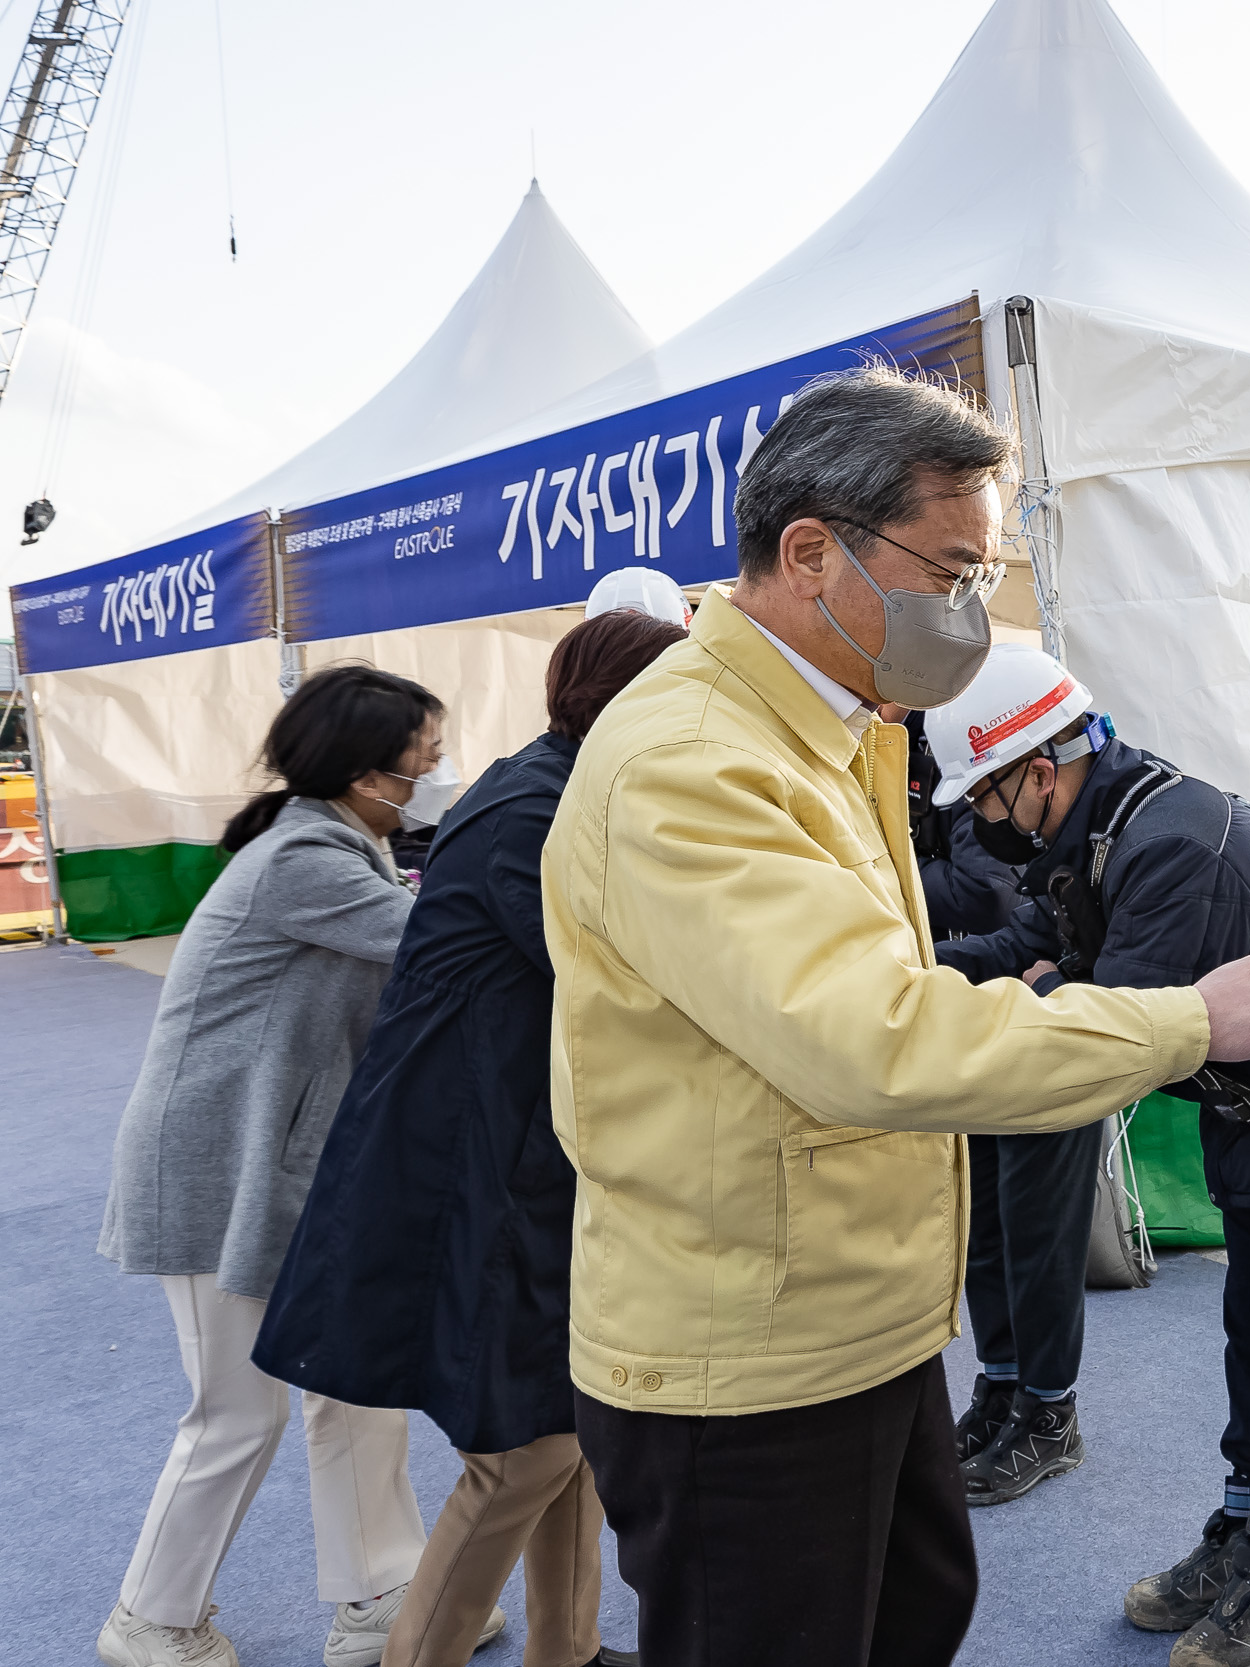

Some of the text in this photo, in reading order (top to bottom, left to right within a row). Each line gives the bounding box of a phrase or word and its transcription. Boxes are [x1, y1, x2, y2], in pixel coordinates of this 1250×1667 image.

[498, 394, 795, 581] 기자대기
[394, 525, 456, 560] EASTPOLE
[100, 549, 216, 646] 기자대기실
[983, 708, 1016, 731] LOTTE
[910, 780, 921, 791] K2
